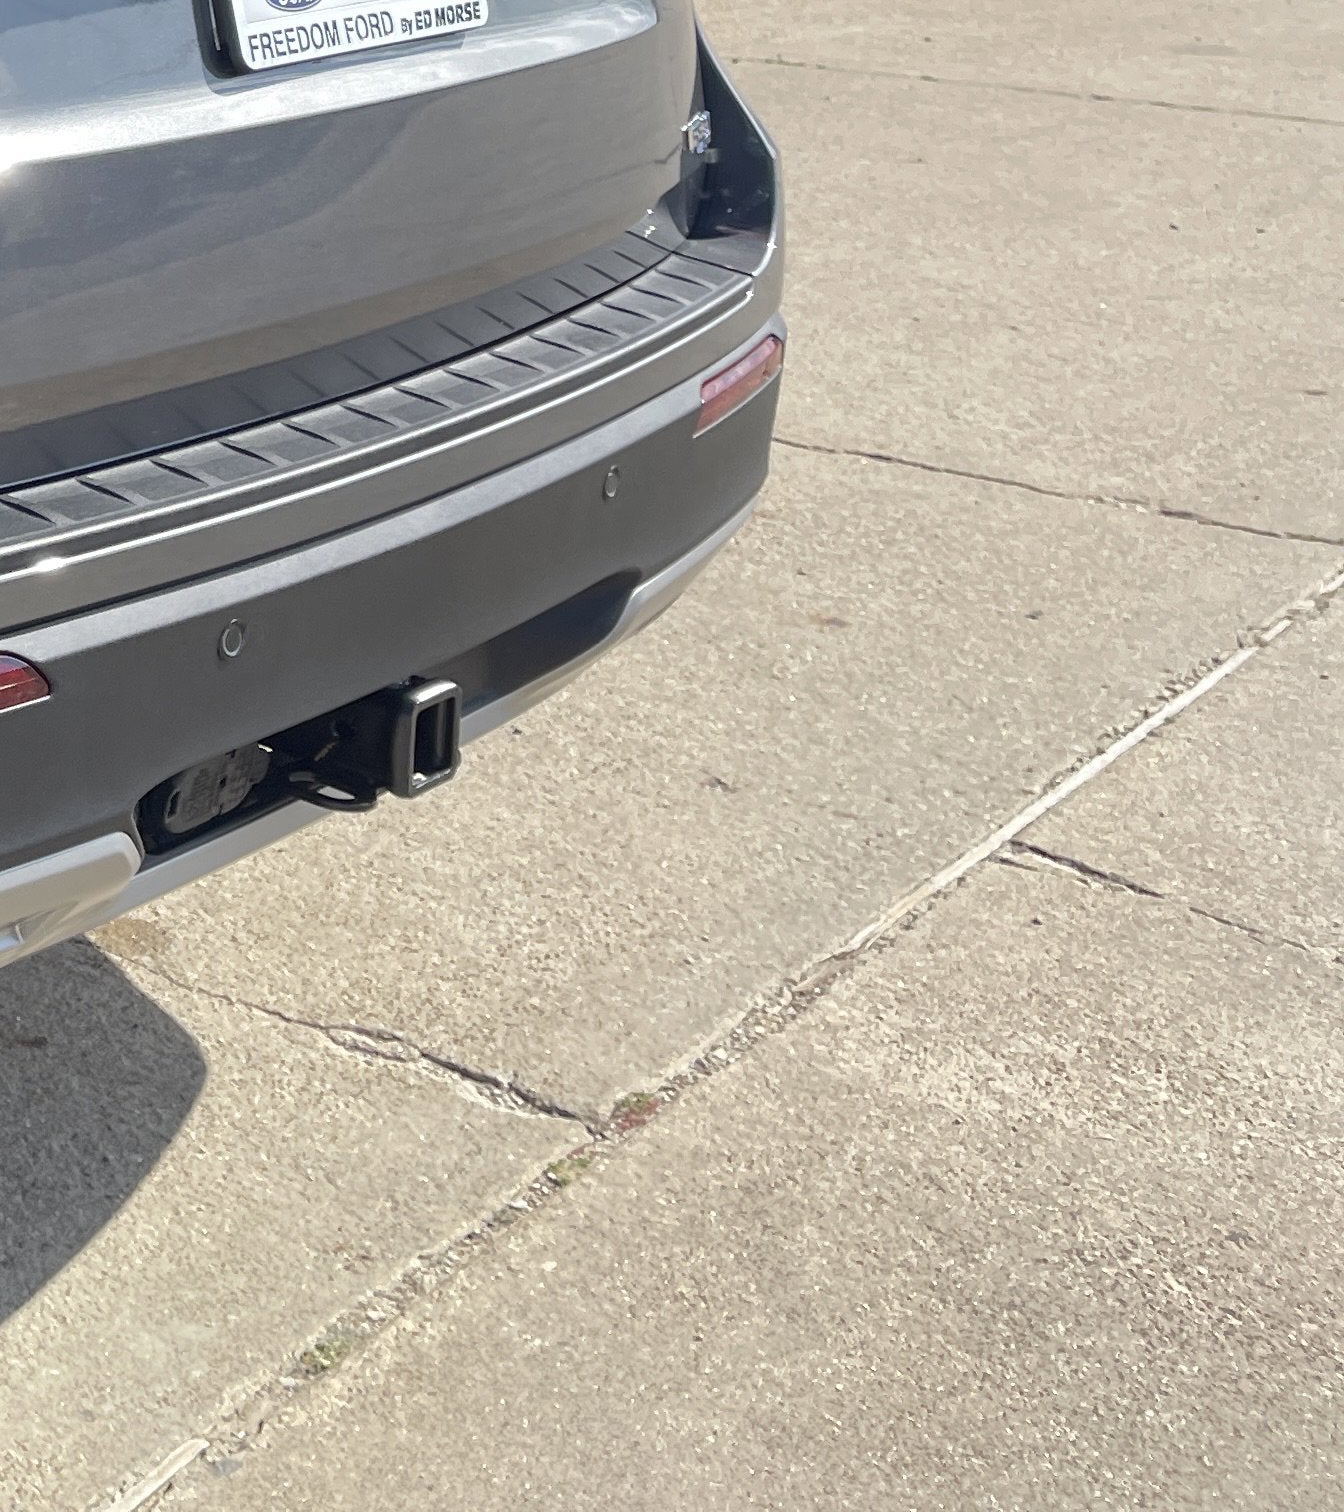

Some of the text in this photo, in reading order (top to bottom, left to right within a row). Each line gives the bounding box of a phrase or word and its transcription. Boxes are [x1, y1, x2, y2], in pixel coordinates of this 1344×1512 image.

[248, 19, 342, 62] FREEDOM
[343, 10, 394, 44] FORD
[414, 8, 433, 30] ED
[435, 1, 481, 27] MORSE
